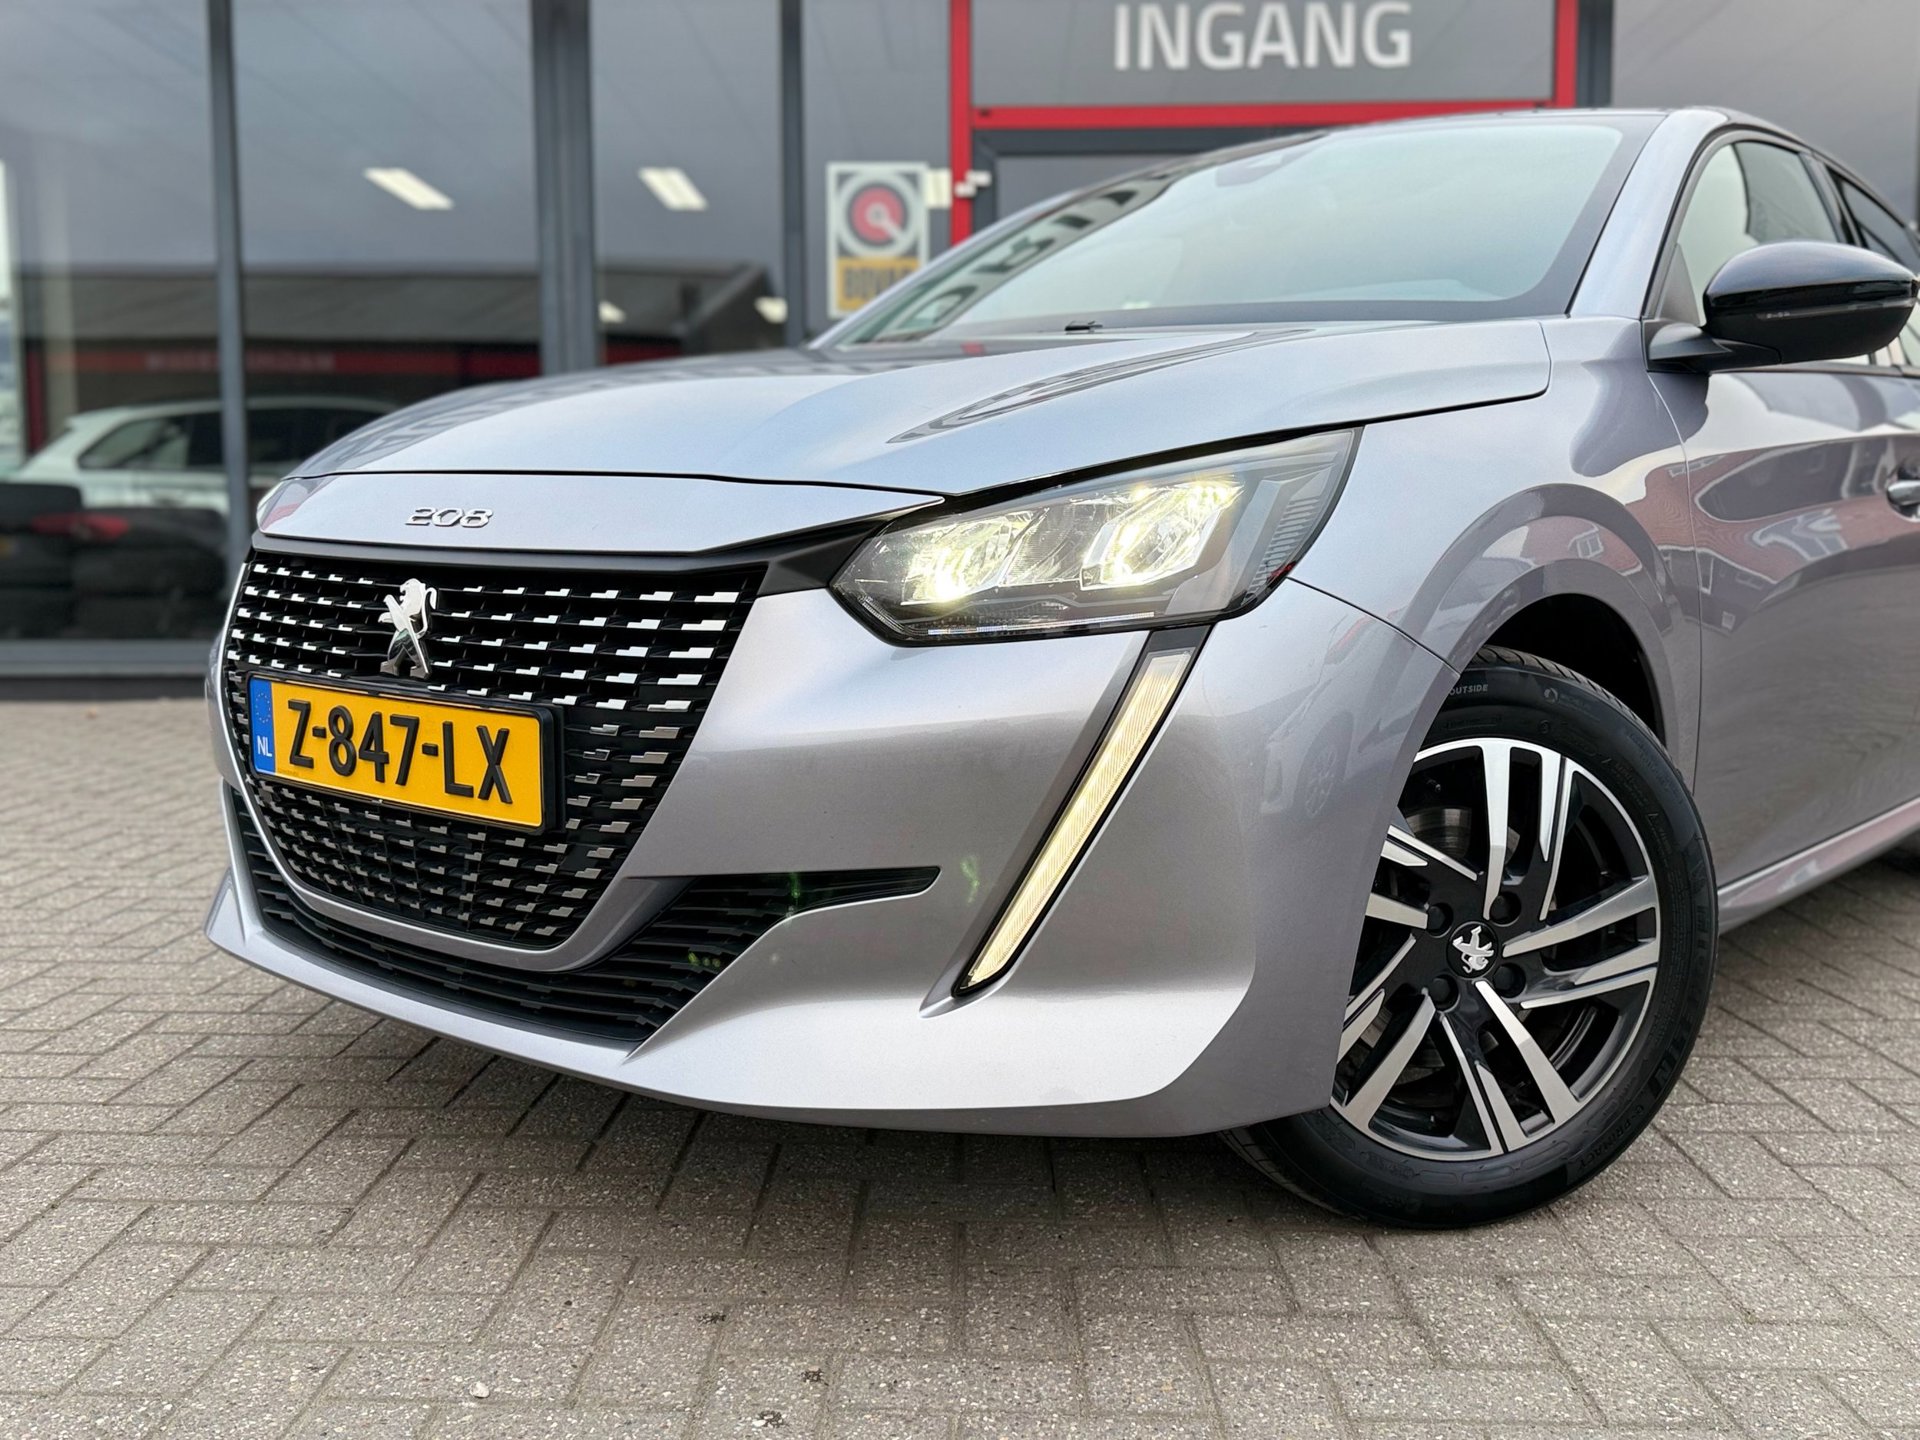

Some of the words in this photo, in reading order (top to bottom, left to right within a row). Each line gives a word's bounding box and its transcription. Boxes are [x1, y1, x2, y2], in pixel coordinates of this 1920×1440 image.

[1114, 1, 1412, 70] INGANG
[404, 507, 493, 528] 208
[257, 735, 273, 757] NL
[287, 698, 514, 805] Z-847-LX
